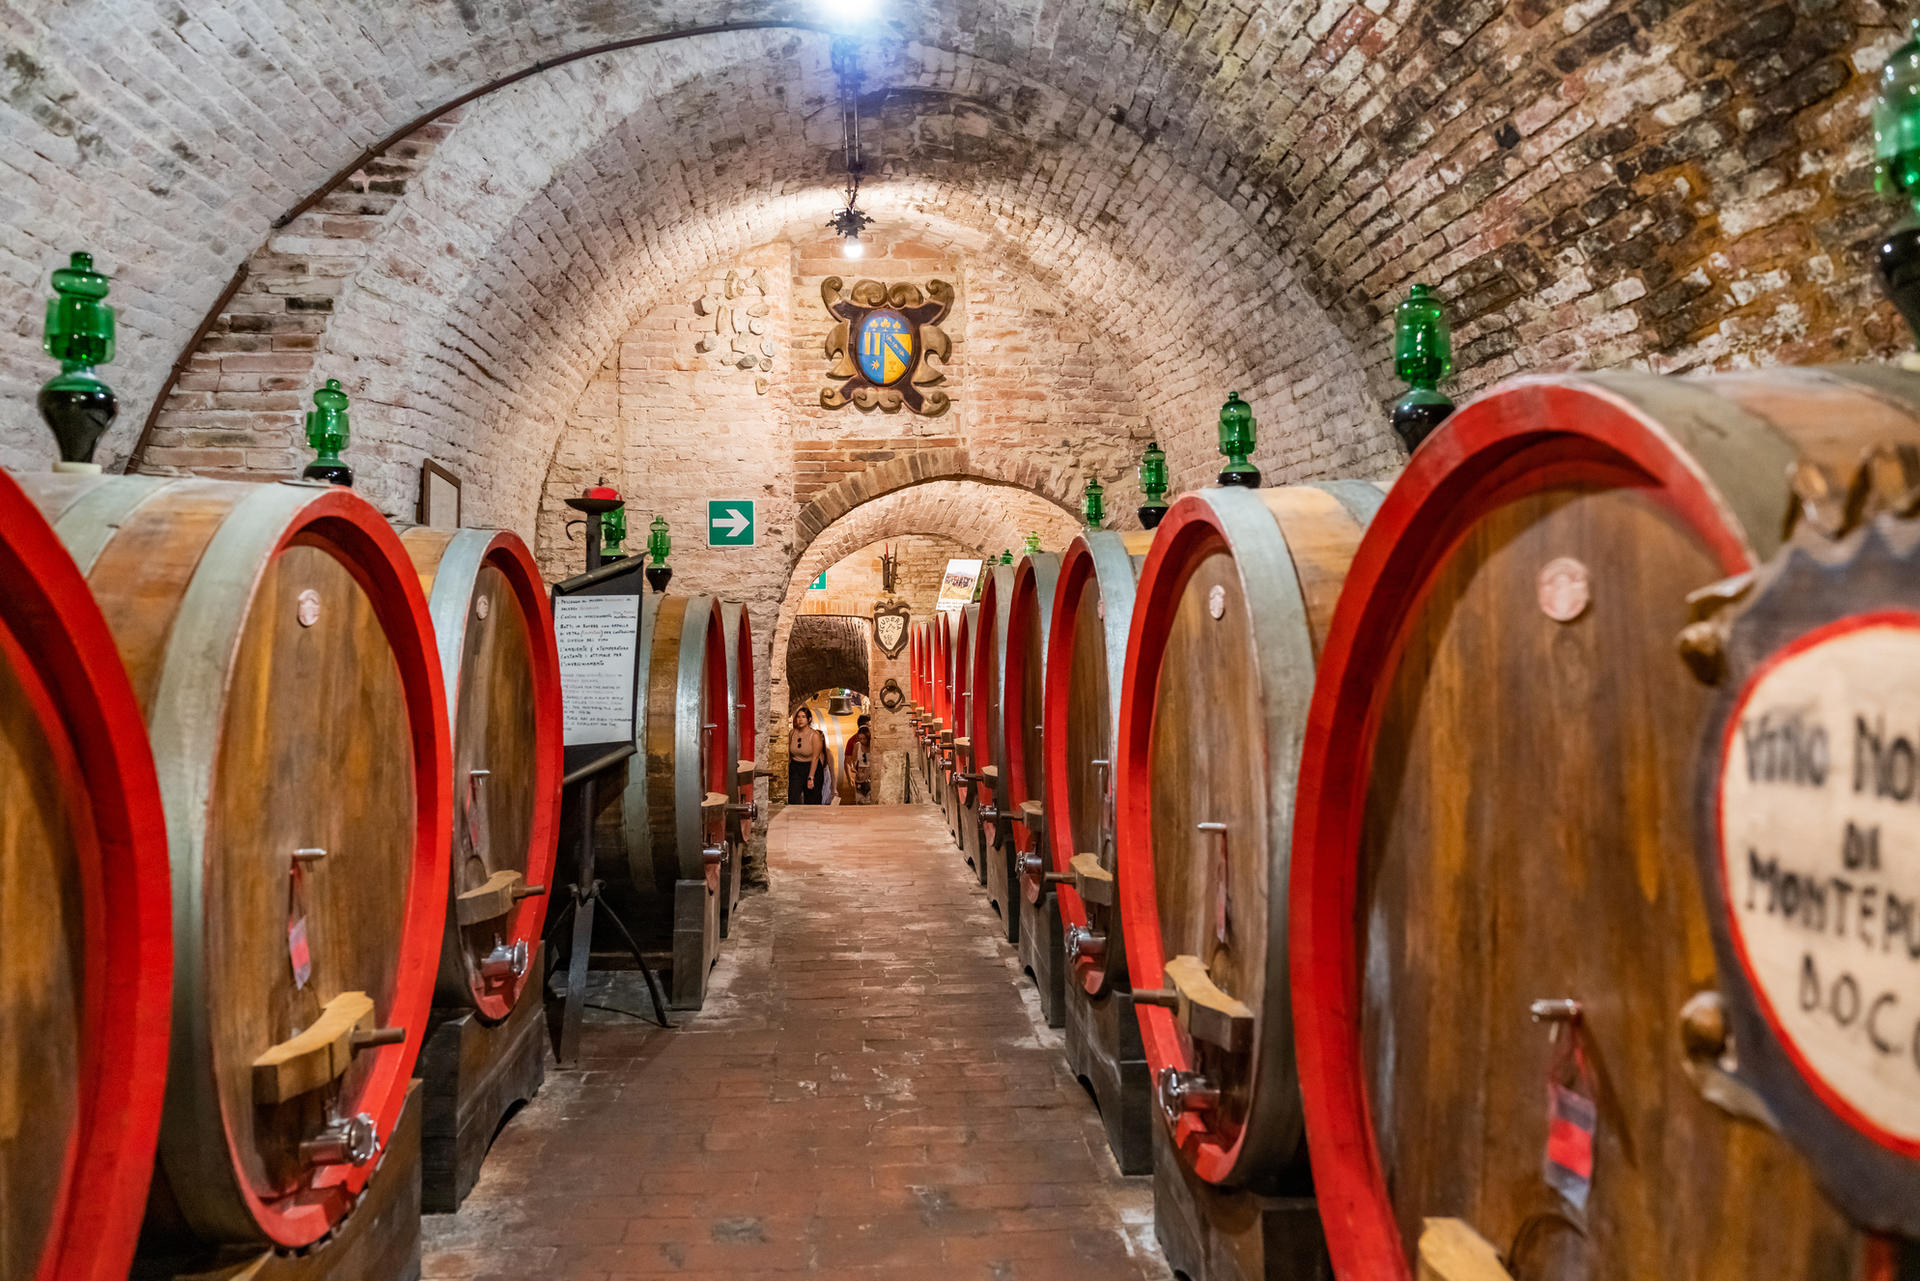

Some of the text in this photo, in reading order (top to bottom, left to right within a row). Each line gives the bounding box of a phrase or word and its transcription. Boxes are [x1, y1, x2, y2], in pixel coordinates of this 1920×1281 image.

[878, 616, 902, 633] SCUDERIA
[1852, 713, 1920, 804] NO
[1843, 819, 1880, 871] DI
